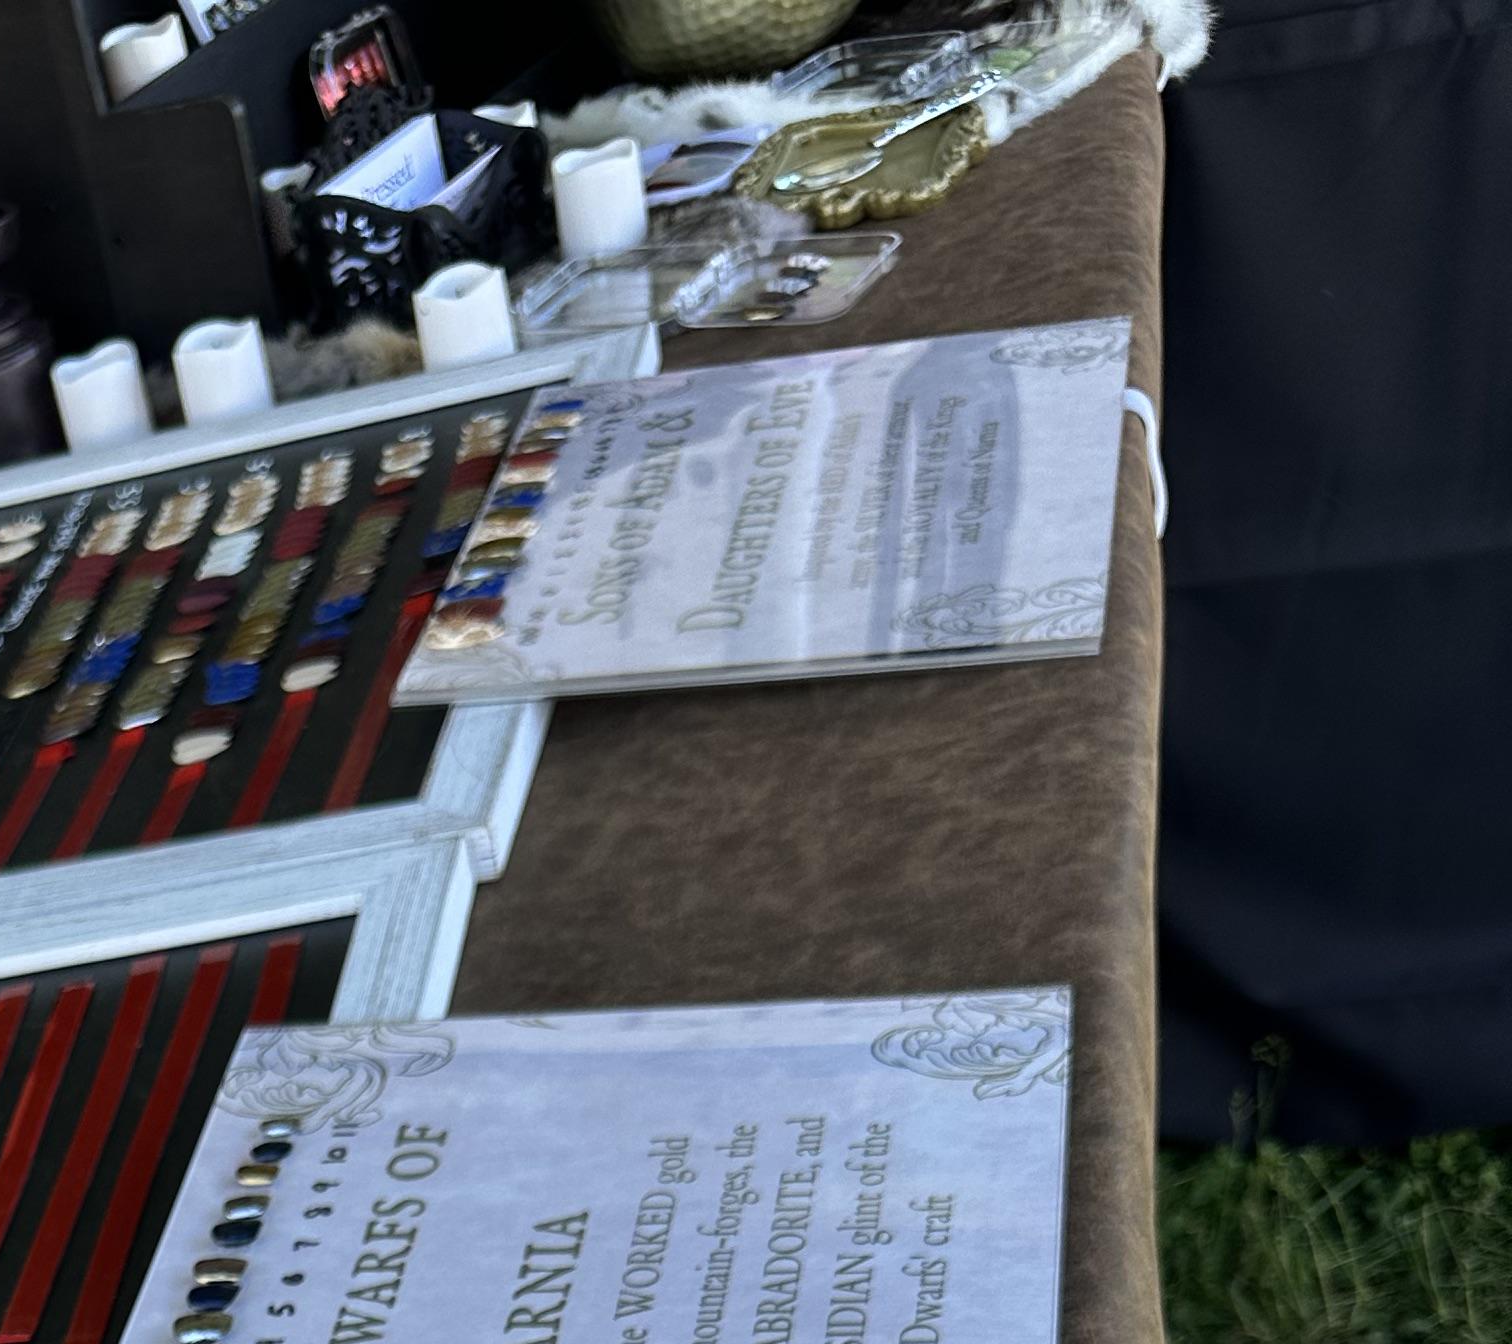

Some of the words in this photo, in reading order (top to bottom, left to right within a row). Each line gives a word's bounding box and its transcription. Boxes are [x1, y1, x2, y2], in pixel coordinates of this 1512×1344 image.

[638, 408, 694, 432] &
[746, 381, 814, 430] EVE
[754, 440, 799, 468] OF
[675, 476, 788, 633] DAUGHTERS
[386, 1124, 447, 1181] OF
[714, 1125, 758, 1158] the
[784, 1115, 826, 1157] and
[848, 1121, 892, 1157] the
[312, 1181, 340, 1193] 9
[844, 1158, 889, 1186] of
[304, 1206, 331, 1219] 8
[613, 1190, 678, 1321] WORKED
[647, 1135, 698, 1184] gold
[837, 1191, 892, 1245] glint
[909, 1194, 954, 1246] craft
[294, 1240, 319, 1252] 7
[269, 1303, 294, 1317] 5
